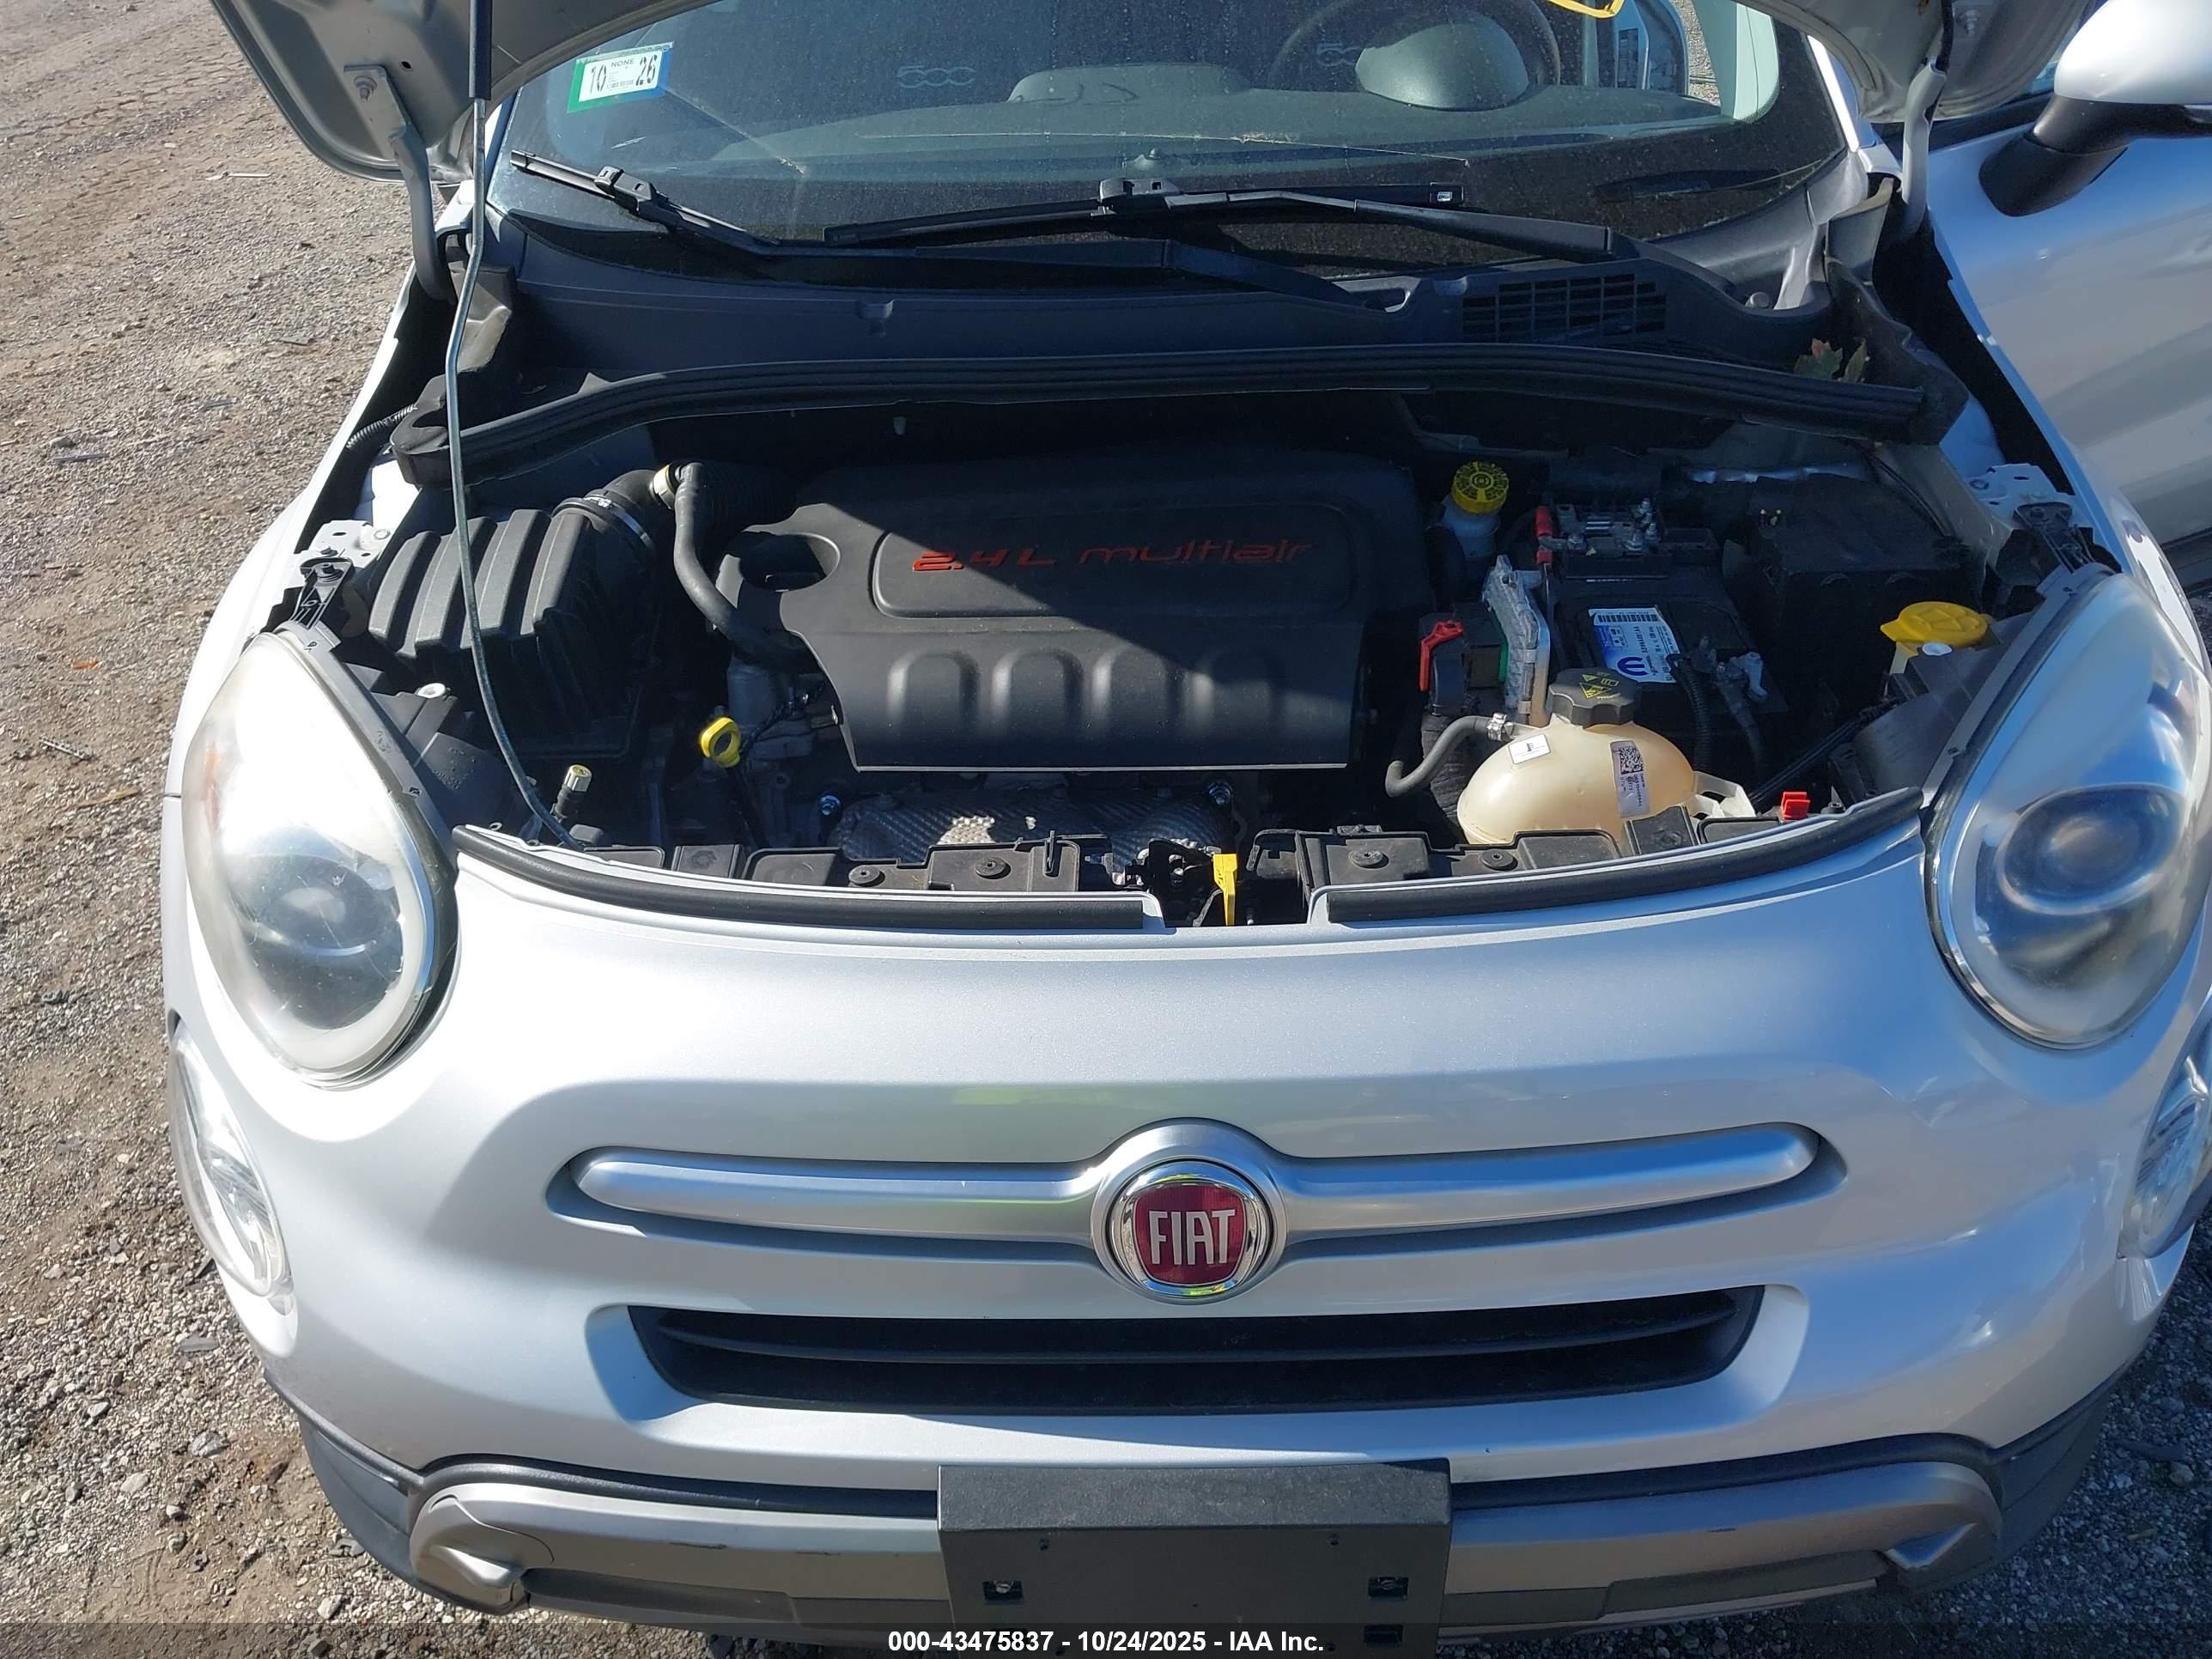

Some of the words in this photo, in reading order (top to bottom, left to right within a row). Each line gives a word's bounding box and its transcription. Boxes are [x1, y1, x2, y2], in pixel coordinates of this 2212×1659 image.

[610, 58, 635, 68] NONE
[635, 54, 659, 87] 26
[589, 64, 607, 95] 10
[1148, 1208, 1237, 1266] FIAT
